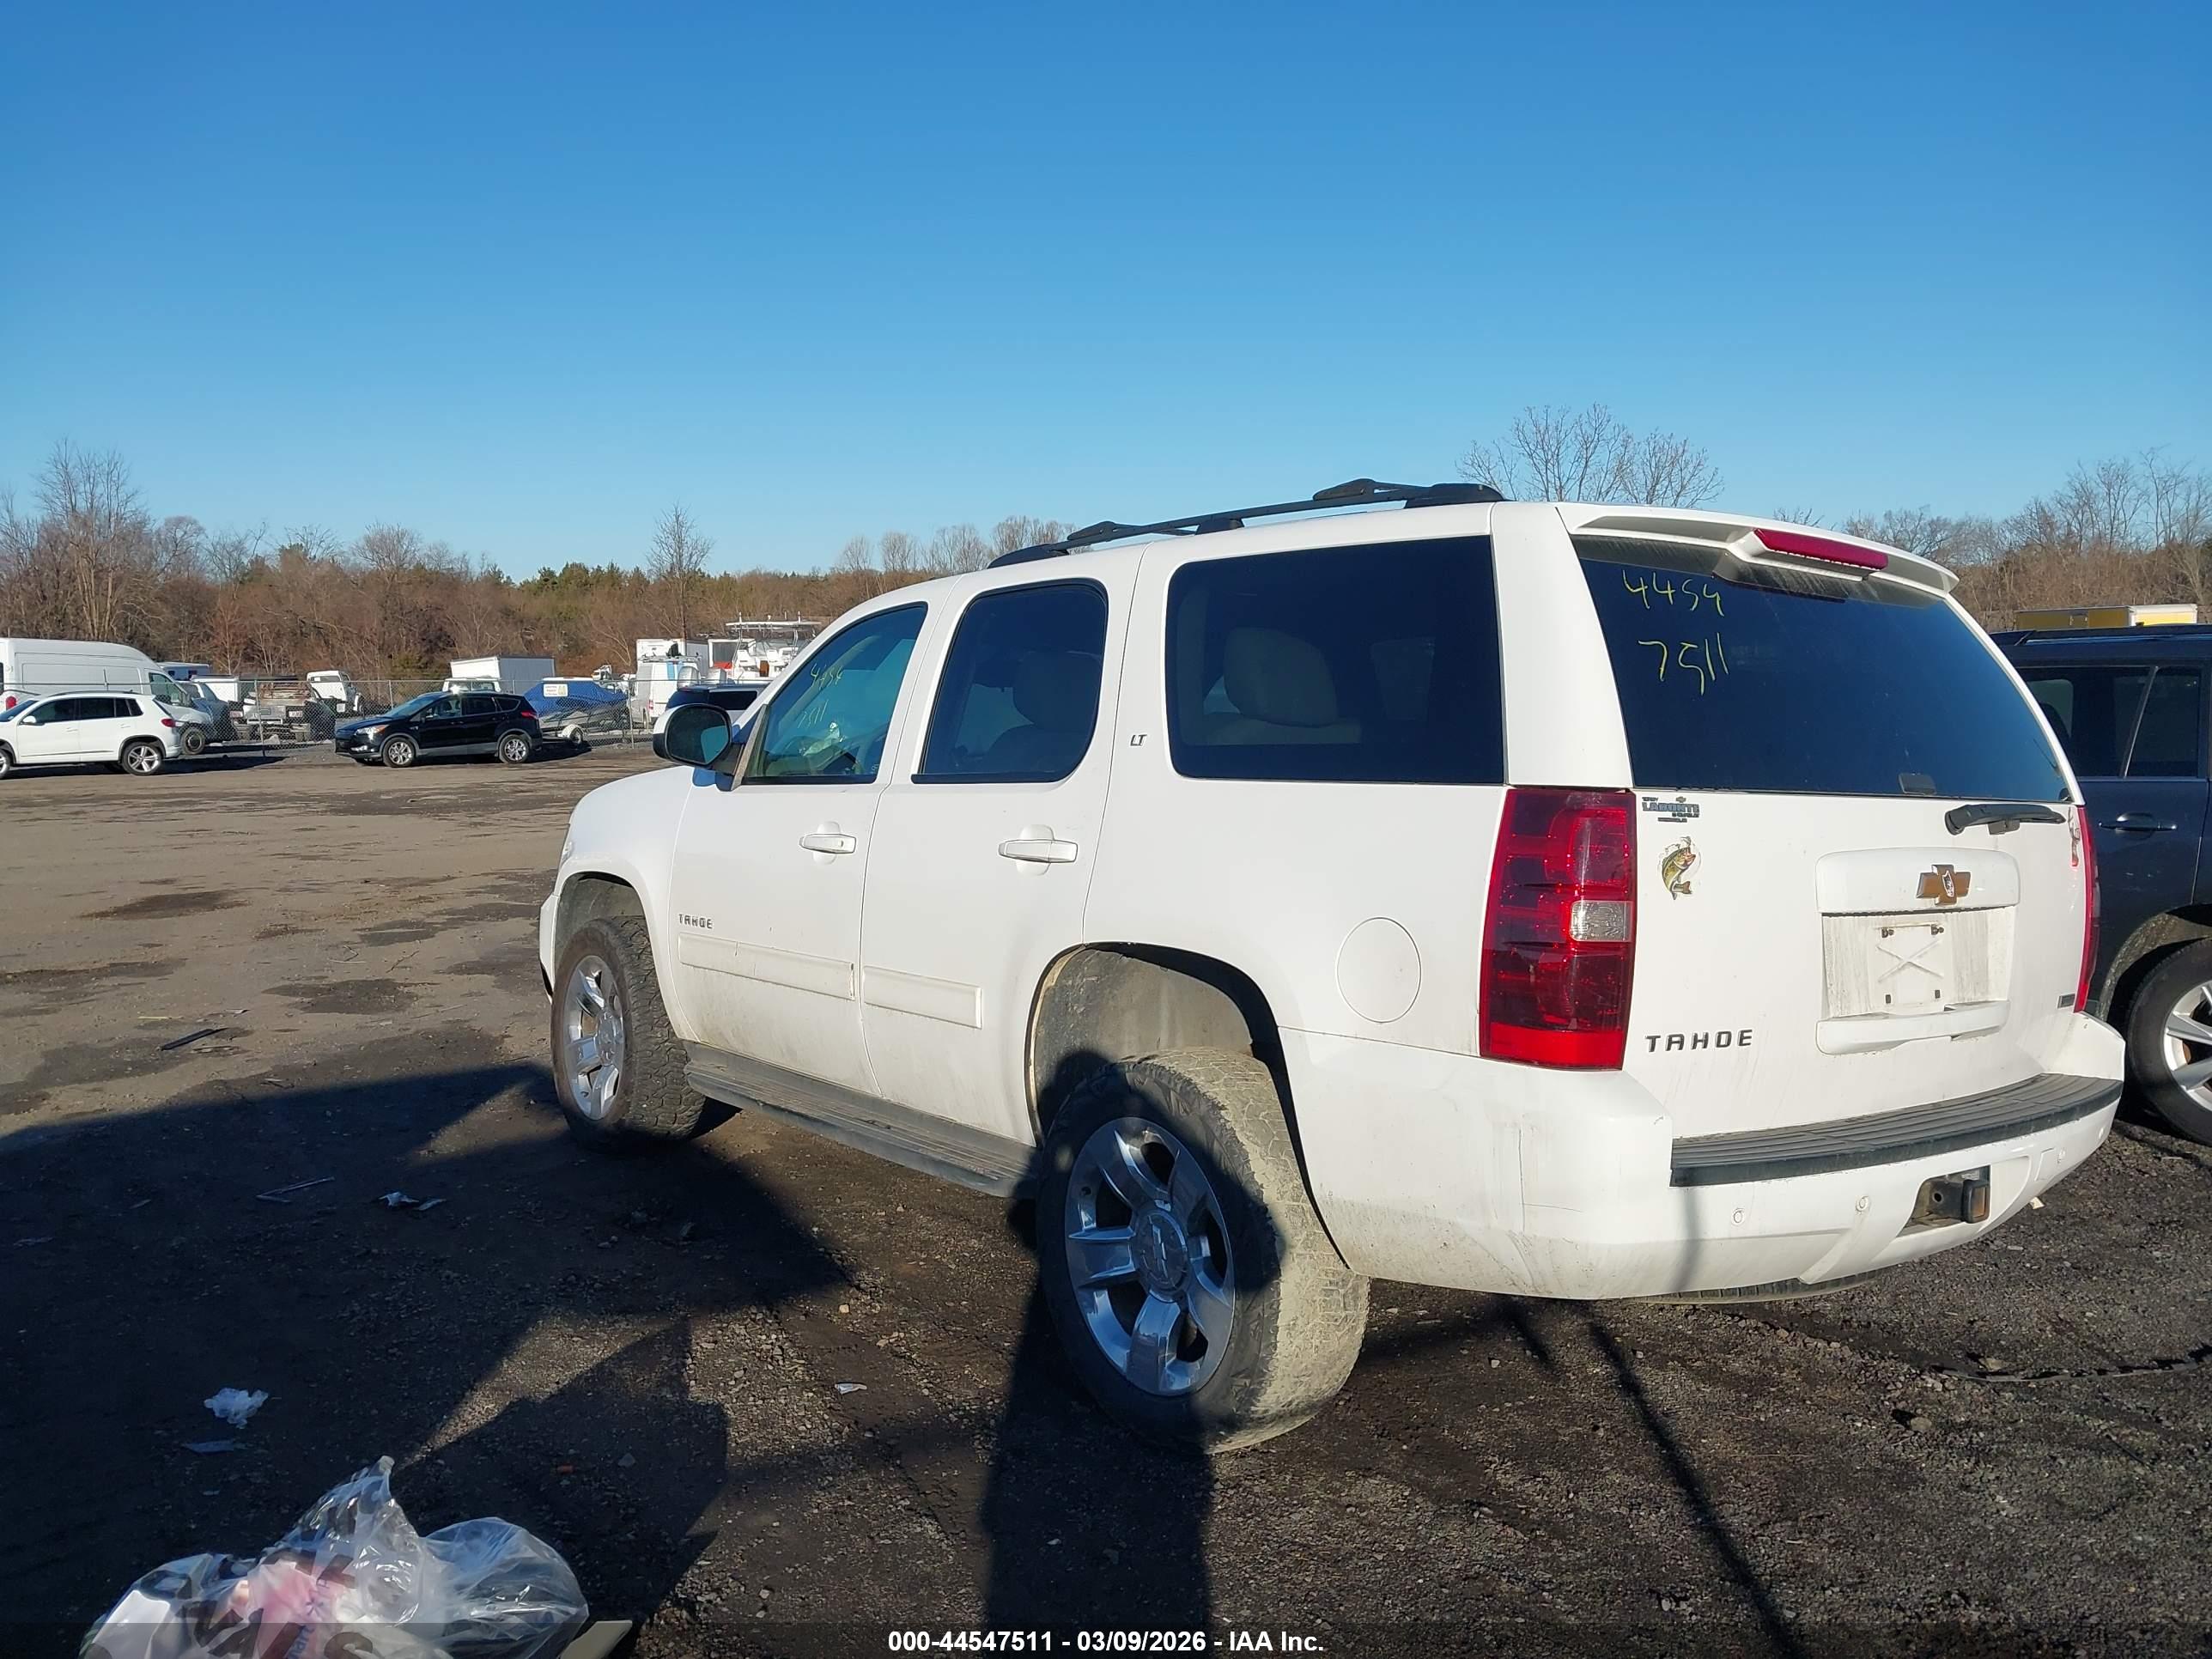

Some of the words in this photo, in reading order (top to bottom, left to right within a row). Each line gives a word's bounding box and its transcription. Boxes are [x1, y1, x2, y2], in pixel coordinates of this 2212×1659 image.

[1623, 569, 1725, 617] 4454
[1638, 632, 1729, 696] 7511
[1130, 733, 1148, 747] LT
[678, 913, 714, 929] TAHOE
[1645, 1029, 1753, 1053] TAHOE
